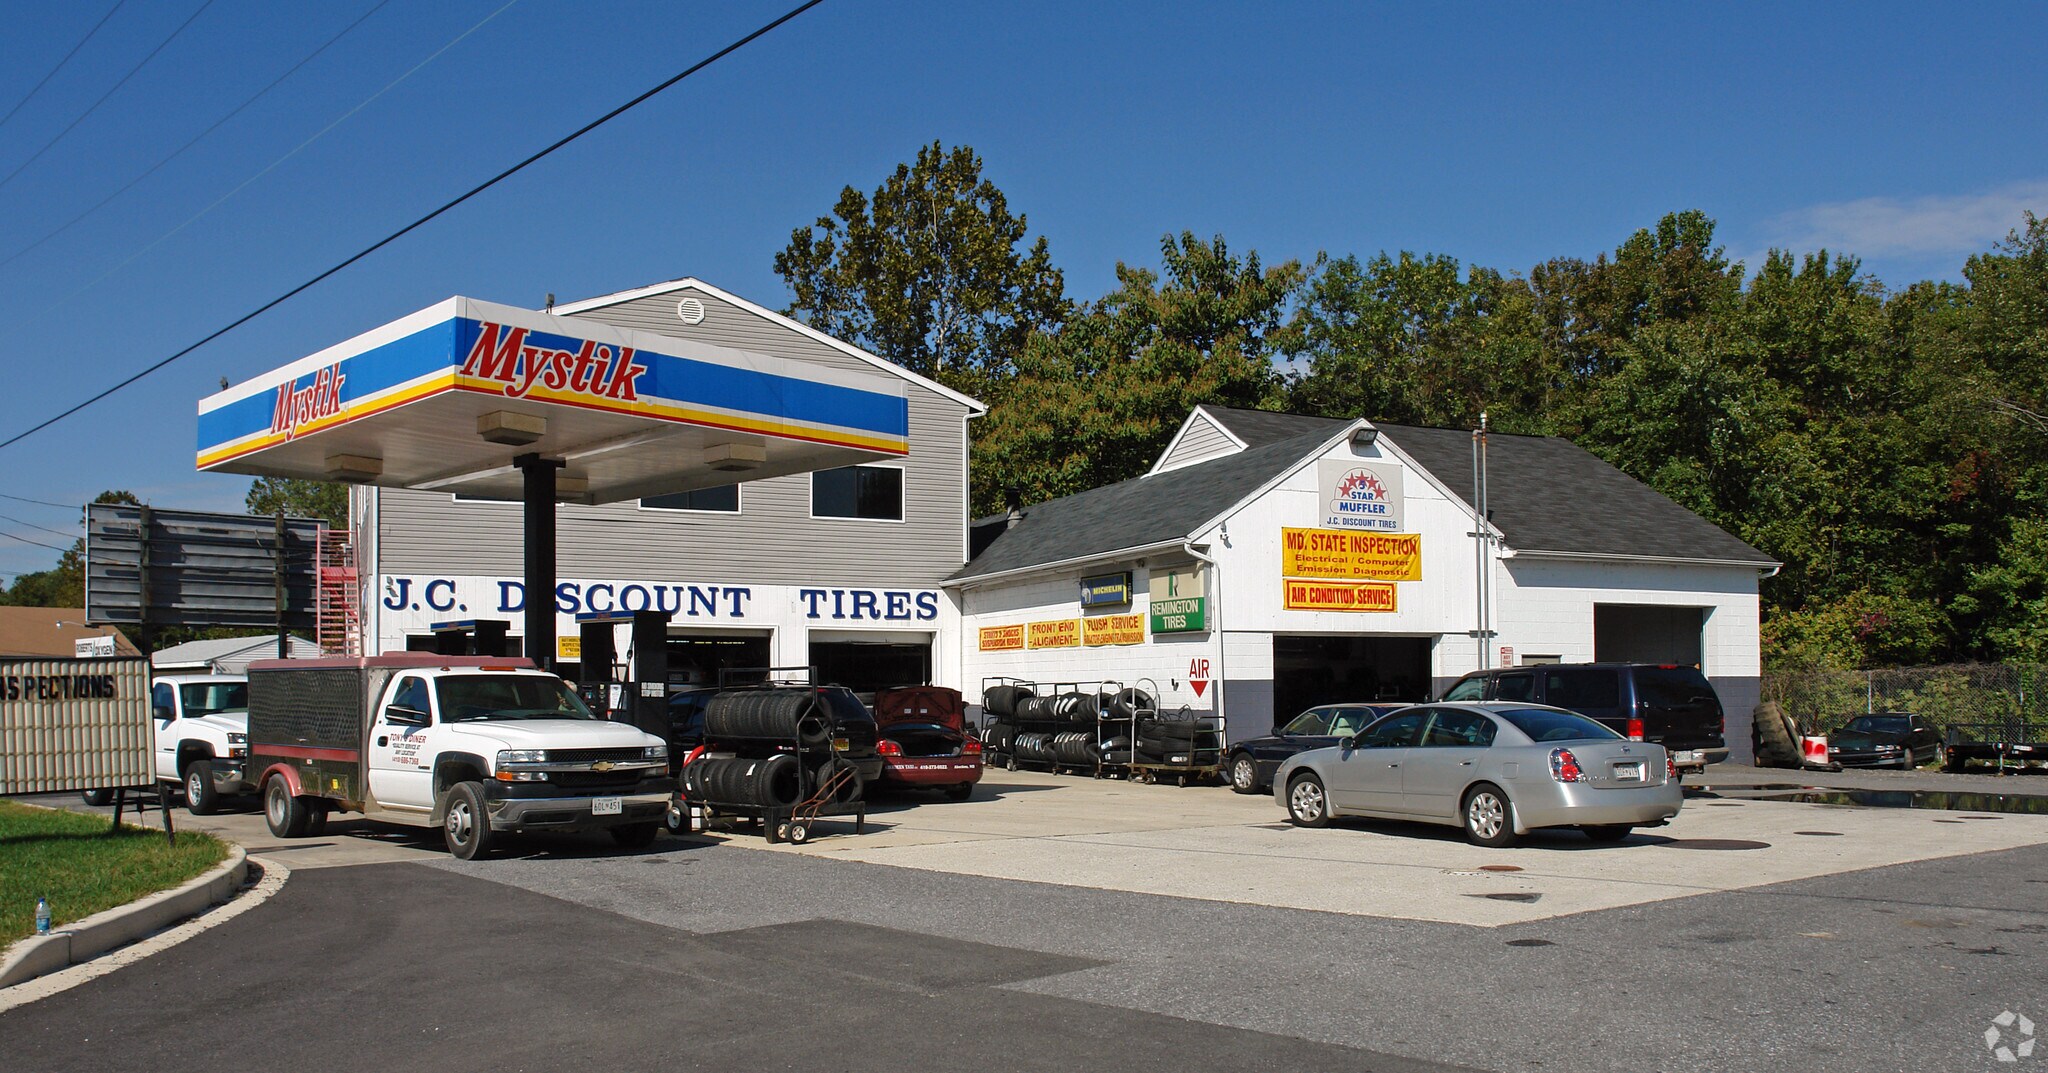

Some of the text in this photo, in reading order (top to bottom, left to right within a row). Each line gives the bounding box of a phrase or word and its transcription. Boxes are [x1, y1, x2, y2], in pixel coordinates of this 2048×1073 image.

[460, 321, 646, 398] Mystik
[271, 363, 345, 440] Mystik
[1359, 480, 1366, 490] 5
[1351, 492, 1374, 500] STAR
[1339, 502, 1386, 514] MUFFLER
[1327, 516, 1397, 528] J.C. DISCOUNT TIRES
[1287, 532, 1417, 555] MD. STATE INSPECTION
[1295, 554, 1348, 564] Electrical
[1358, 557, 1410, 568] Computer
[1296, 565, 1410, 577] Emission Diagnostic
[1093, 584, 1122, 594] MICHELIN
[1291, 587, 1391, 605] AIR CONDITION SERVICE
[383, 578, 938, 621] J.C. DSCOUNT TIRES
[1151, 599, 1199, 616] REMINGTON
[1032, 622, 1075, 635] FRONT END
[1087, 616, 1139, 632] FLUSH SERVICE
[1162, 615, 1187, 629] TIRES
[1189, 658, 1210, 679] AIR
[409, 735, 426, 743] DINER
